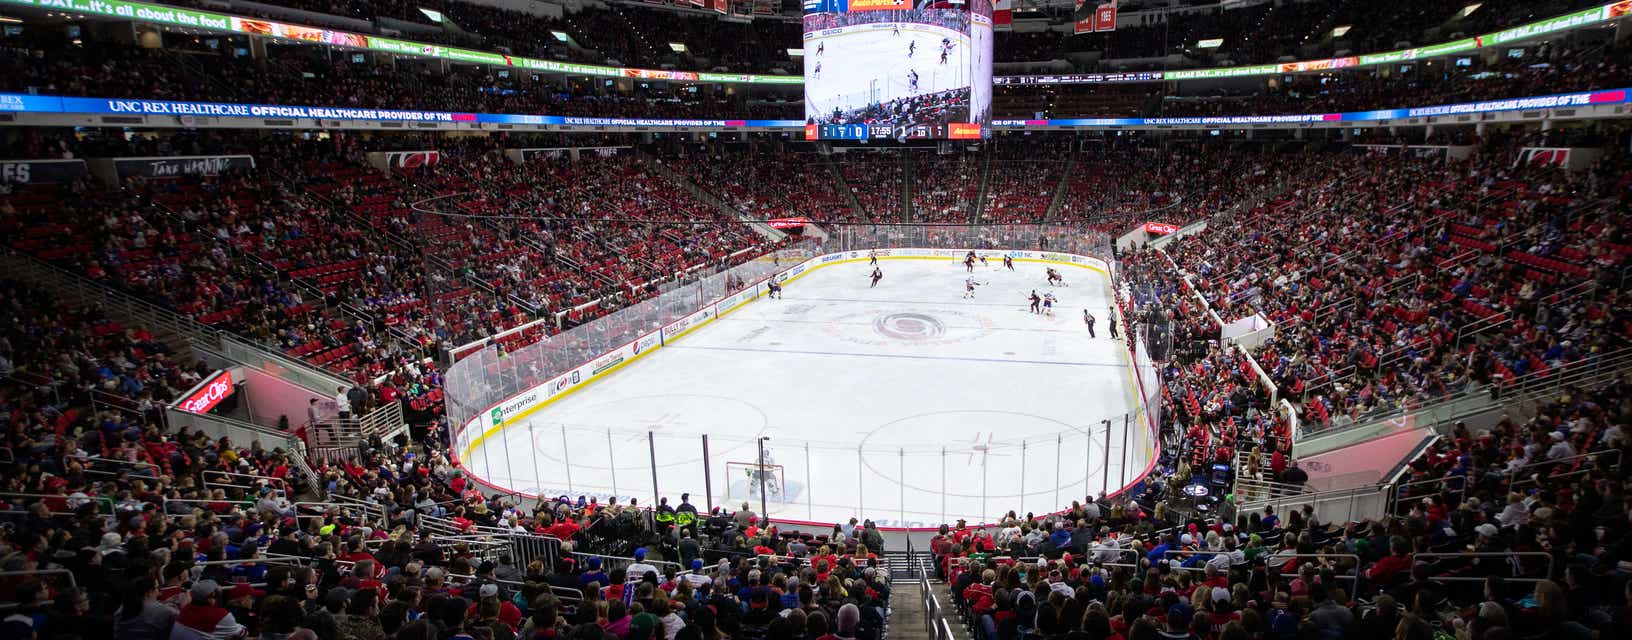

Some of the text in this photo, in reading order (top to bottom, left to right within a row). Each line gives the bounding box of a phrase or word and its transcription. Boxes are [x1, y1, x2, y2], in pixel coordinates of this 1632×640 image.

[116, 5, 134, 17] all
[136, 6, 176, 22] about
[177, 11, 198, 26] the
[200, 15, 226, 29] food
[1557, 96, 1570, 106] OF
[1570, 93, 1591, 105] THE
[108, 101, 141, 112] UNC
[143, 101, 170, 113] REX
[171, 102, 249, 116] HEALTHCARE
[251, 106, 308, 117] OFFICIAL
[309, 108, 377, 119] HEALTHCARE
[378, 110, 423, 120] PROVIDER
[424, 111, 435, 120] OF
[436, 112, 452, 121] THE
[1202, 116, 1231, 124] OFFICIAL
[871, 127, 891, 135] 17:55
[901, 126, 907, 137] 1
[0, 162, 31, 182] ES
[1149, 223, 1163, 232] Great
[185, 392, 211, 413] Great
